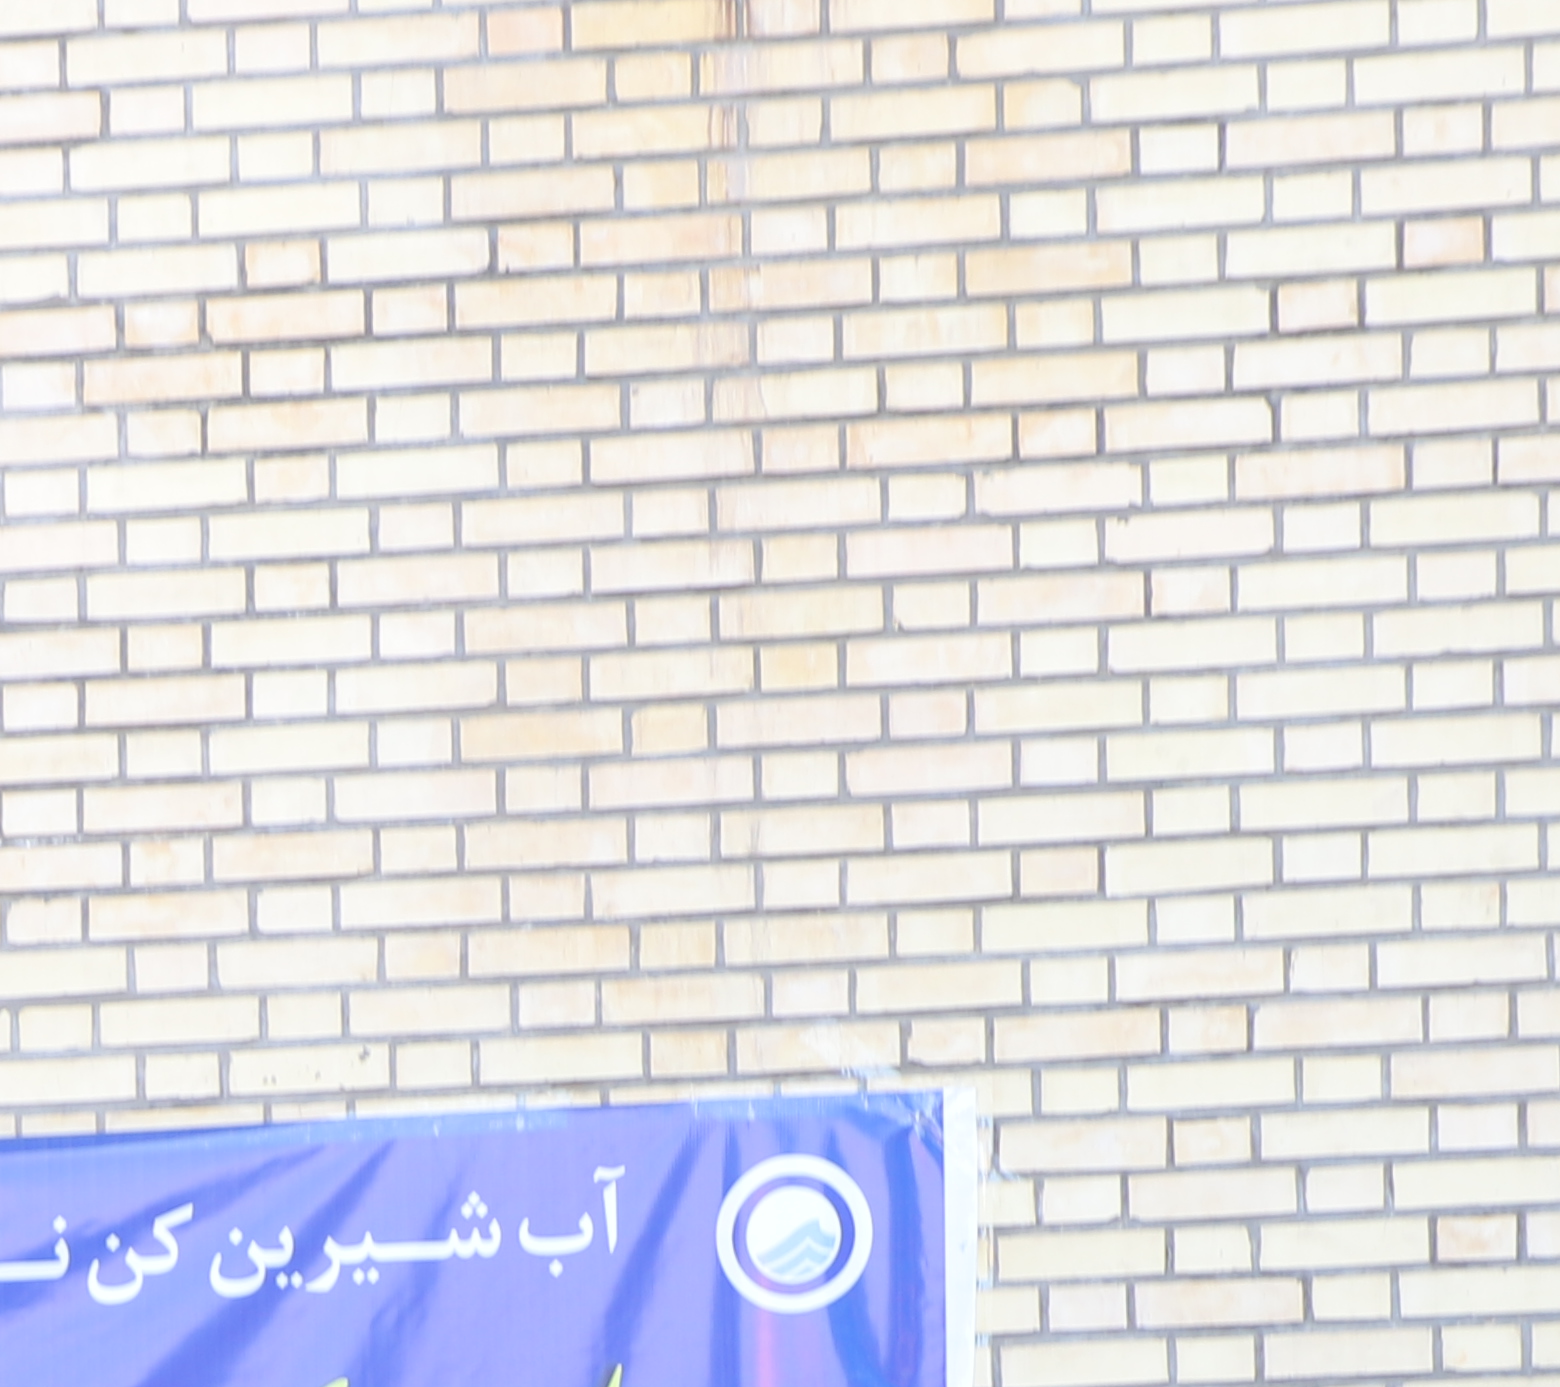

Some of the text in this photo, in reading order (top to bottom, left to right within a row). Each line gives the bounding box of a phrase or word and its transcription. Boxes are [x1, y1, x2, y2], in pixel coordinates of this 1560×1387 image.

[87, 1202, 195, 1306] کن
[210, 1191, 502, 1296] شیرین
[517, 1165, 626, 1278] آب
